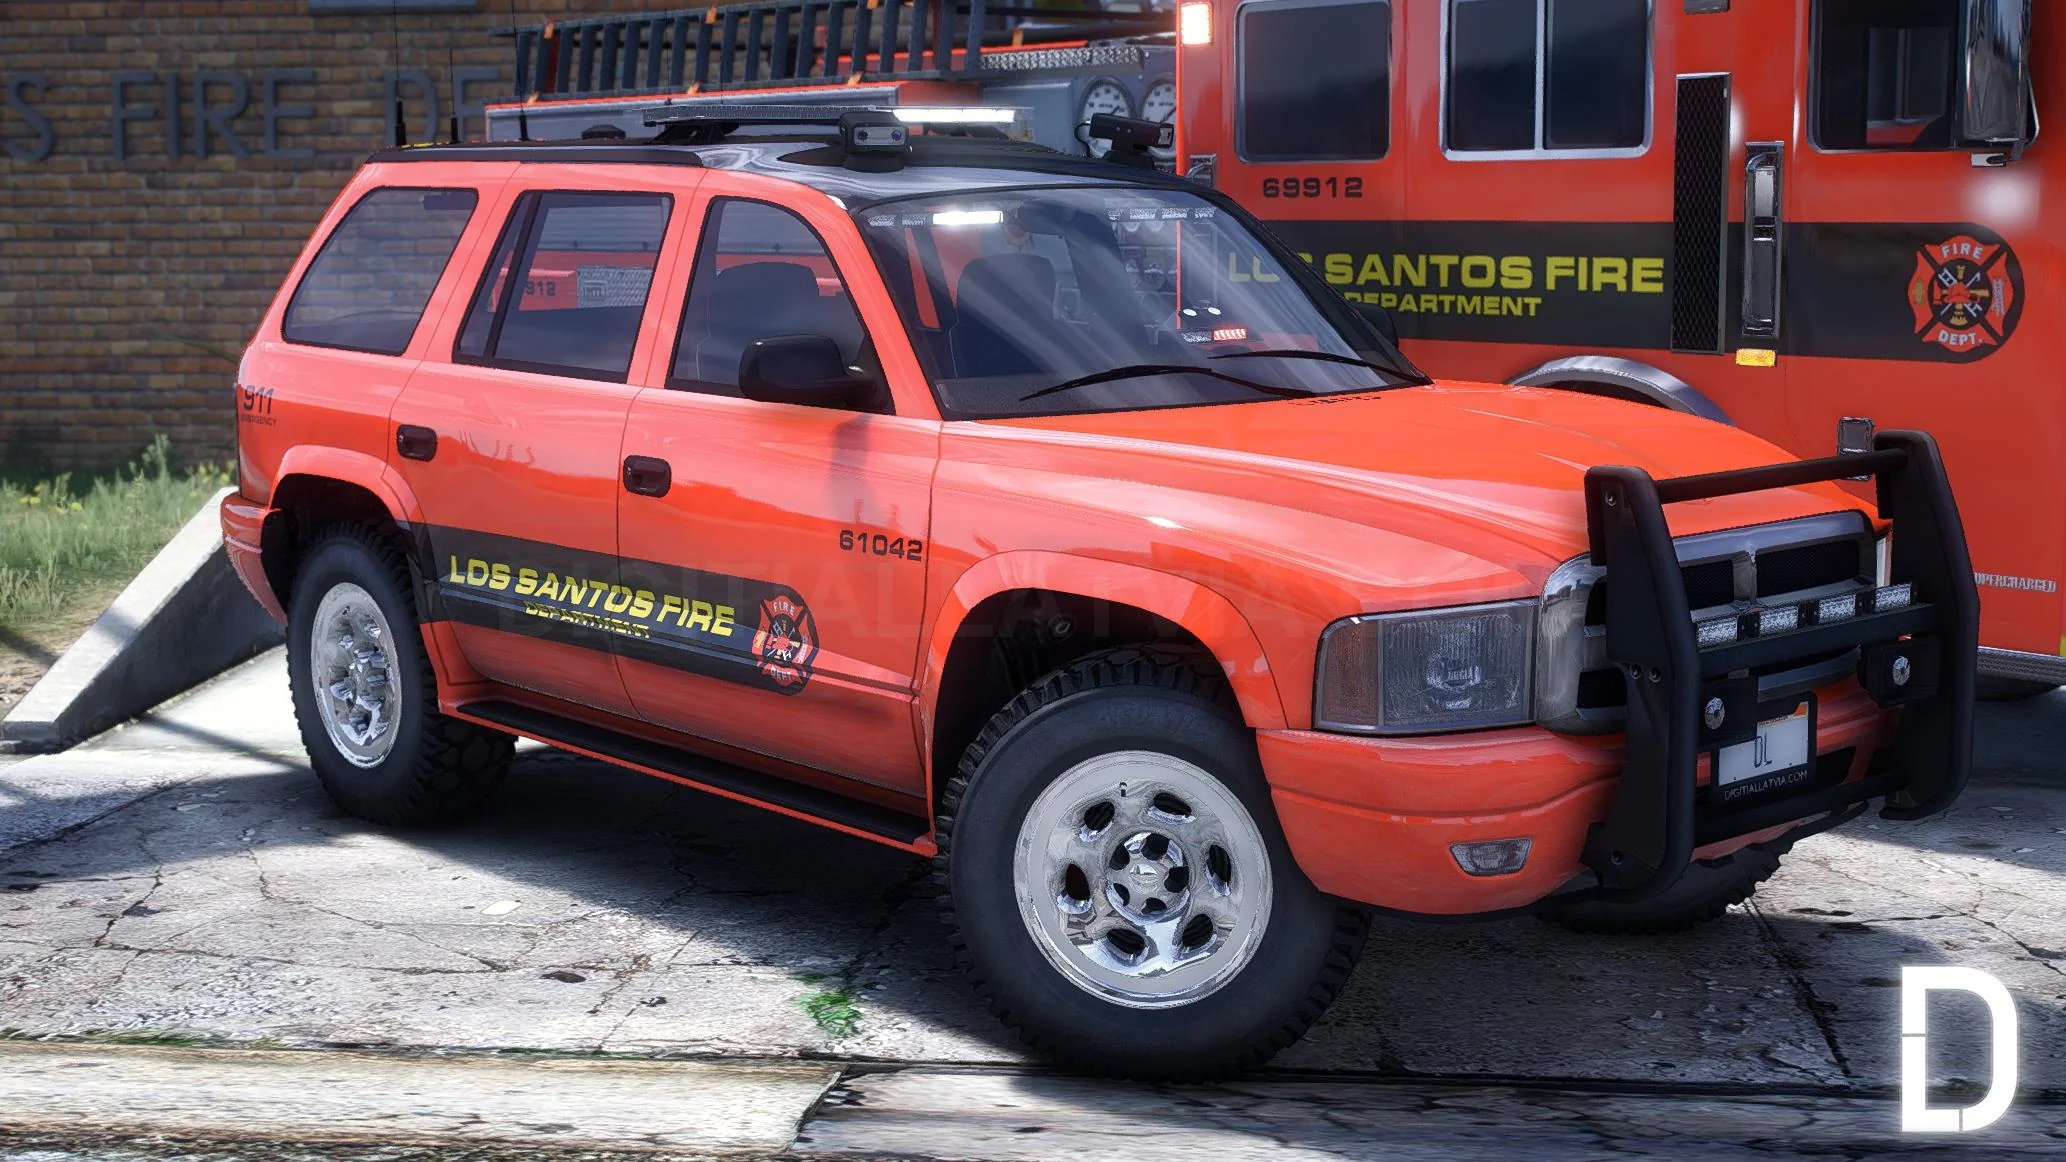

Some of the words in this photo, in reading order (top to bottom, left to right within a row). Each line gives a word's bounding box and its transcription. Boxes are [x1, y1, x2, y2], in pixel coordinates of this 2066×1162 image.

[111, 68, 317, 161] FIRE
[1262, 176, 1363, 198] 69912
[1941, 242, 1984, 260] FIRE
[1324, 252, 1533, 290] SANTOS
[1545, 255, 1665, 292] FIRE
[243, 384, 275, 415] 911
[839, 529, 923, 562] 61042
[449, 554, 512, 591] LOS
[514, 567, 655, 618] SANTOS
[656, 594, 736, 637] FIRE
[1973, 571, 2057, 594] UPERCHARGED
[523, 600, 651, 639] DEPARTMENT
[773, 601, 796, 616] FIRE
[1753, 731, 1773, 769] DL
